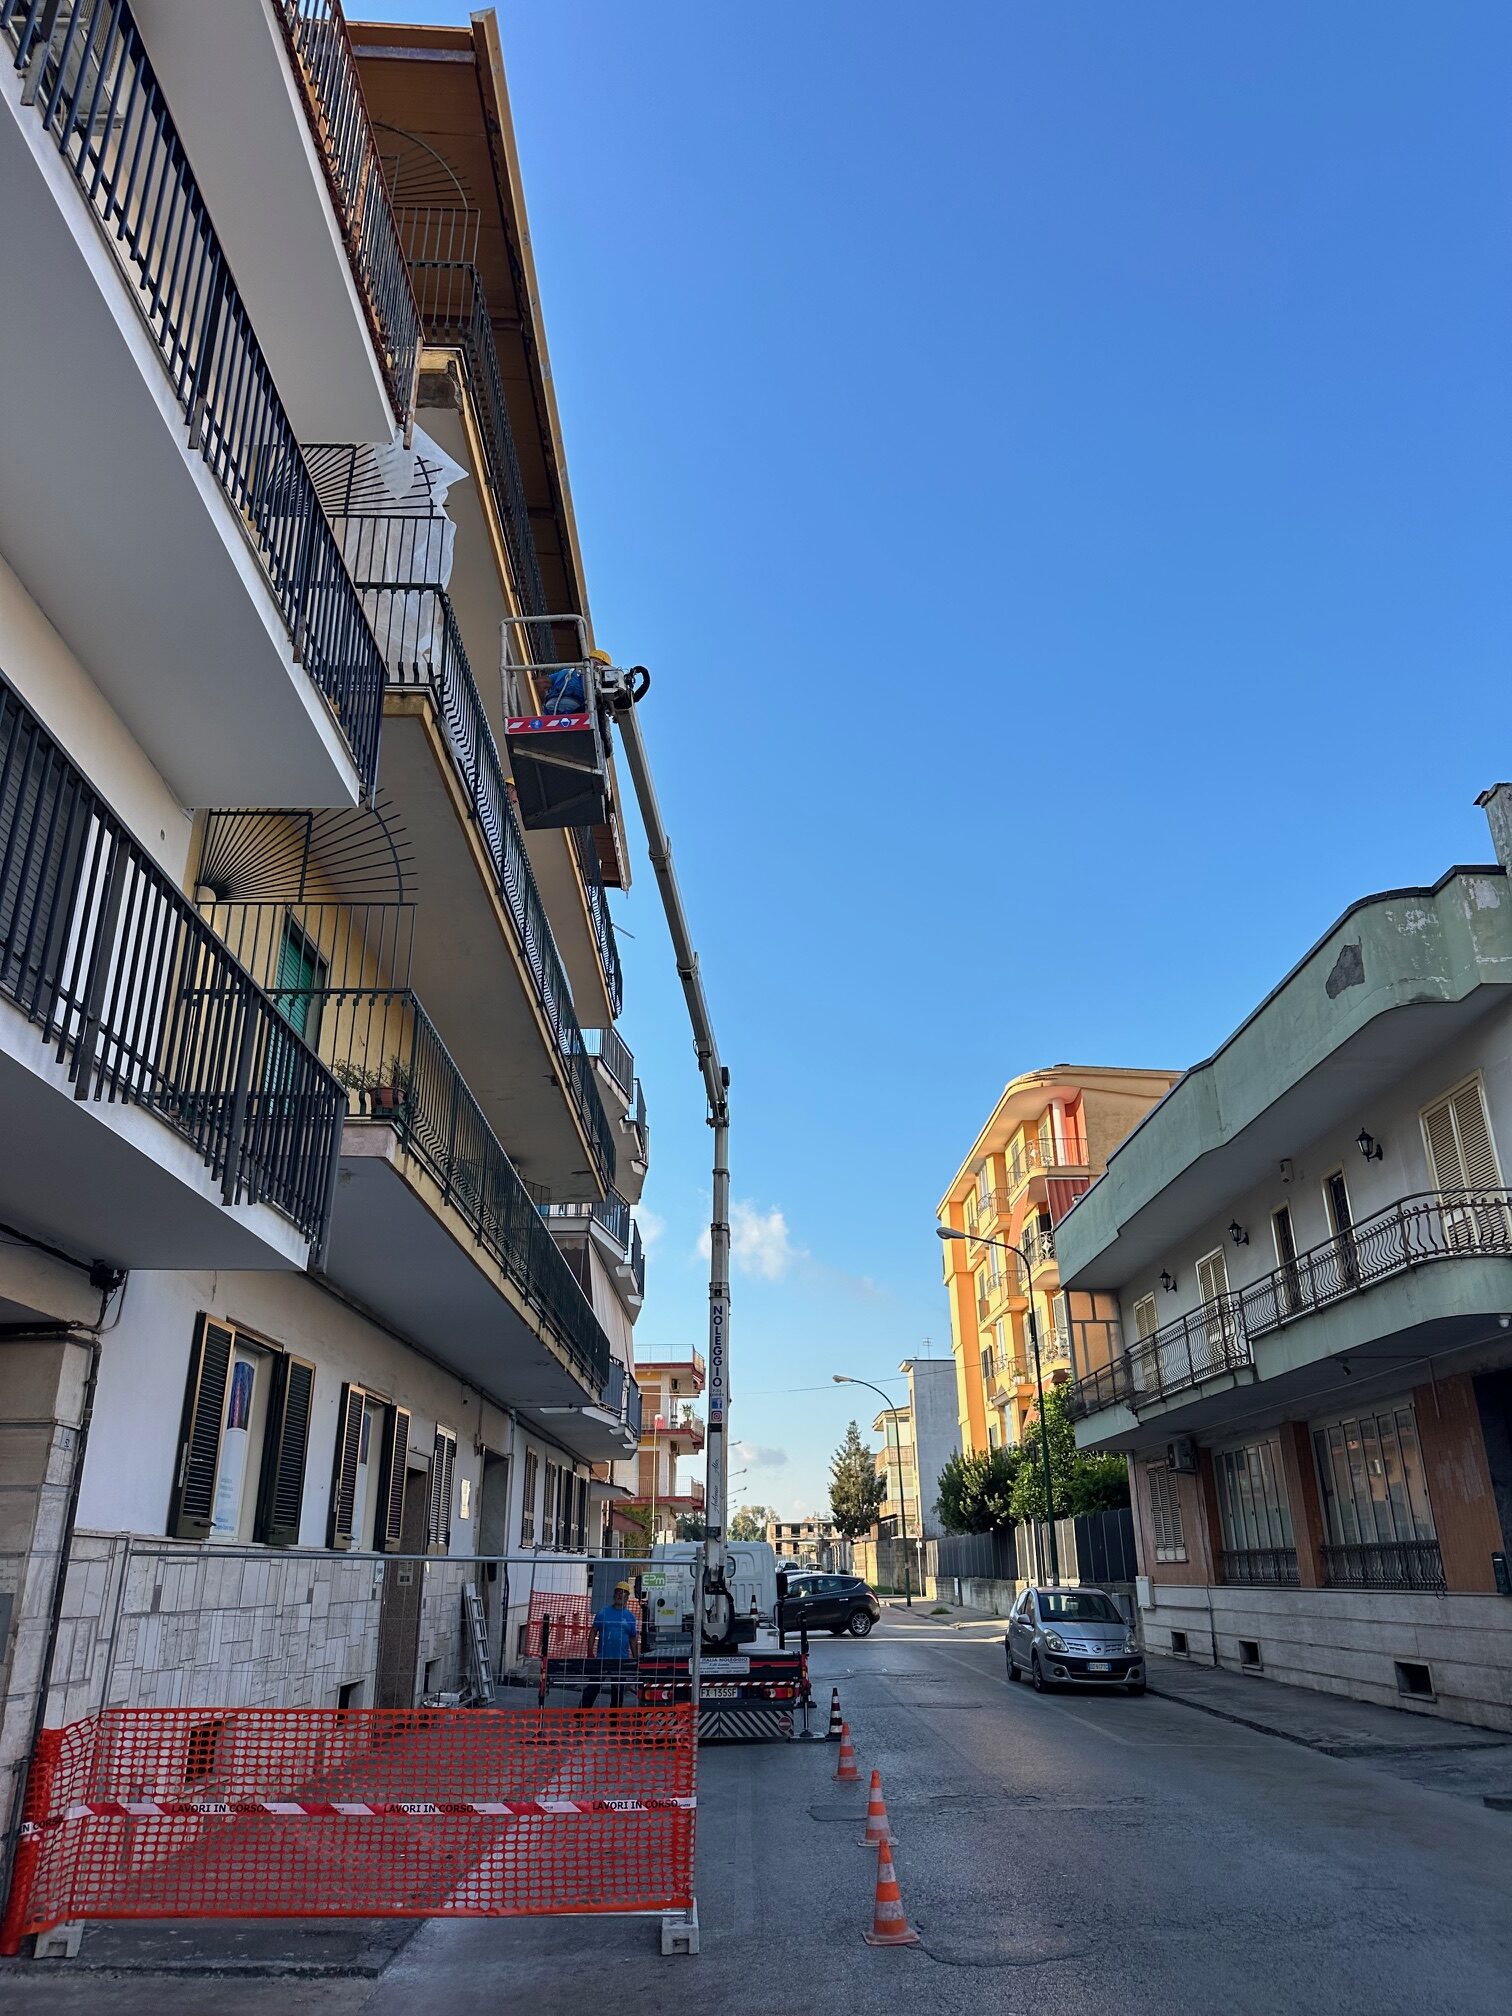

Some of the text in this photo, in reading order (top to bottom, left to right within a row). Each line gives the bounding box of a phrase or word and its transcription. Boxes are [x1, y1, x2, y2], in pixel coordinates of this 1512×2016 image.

[713, 1305, 723, 1388] NOLEGGIO
[701, 1688, 711, 1698] FX
[171, 1804, 210, 1814] LAVORI
[214, 1804, 226, 1813] IN
[229, 1804, 265, 1813] CORSO
[383, 1804, 421, 1814] LAVORI
[424, 1804, 436, 1813] IN
[438, 1804, 473, 1813] CORSO
[592, 1799, 678, 1811] LAVORI IN CORSO
